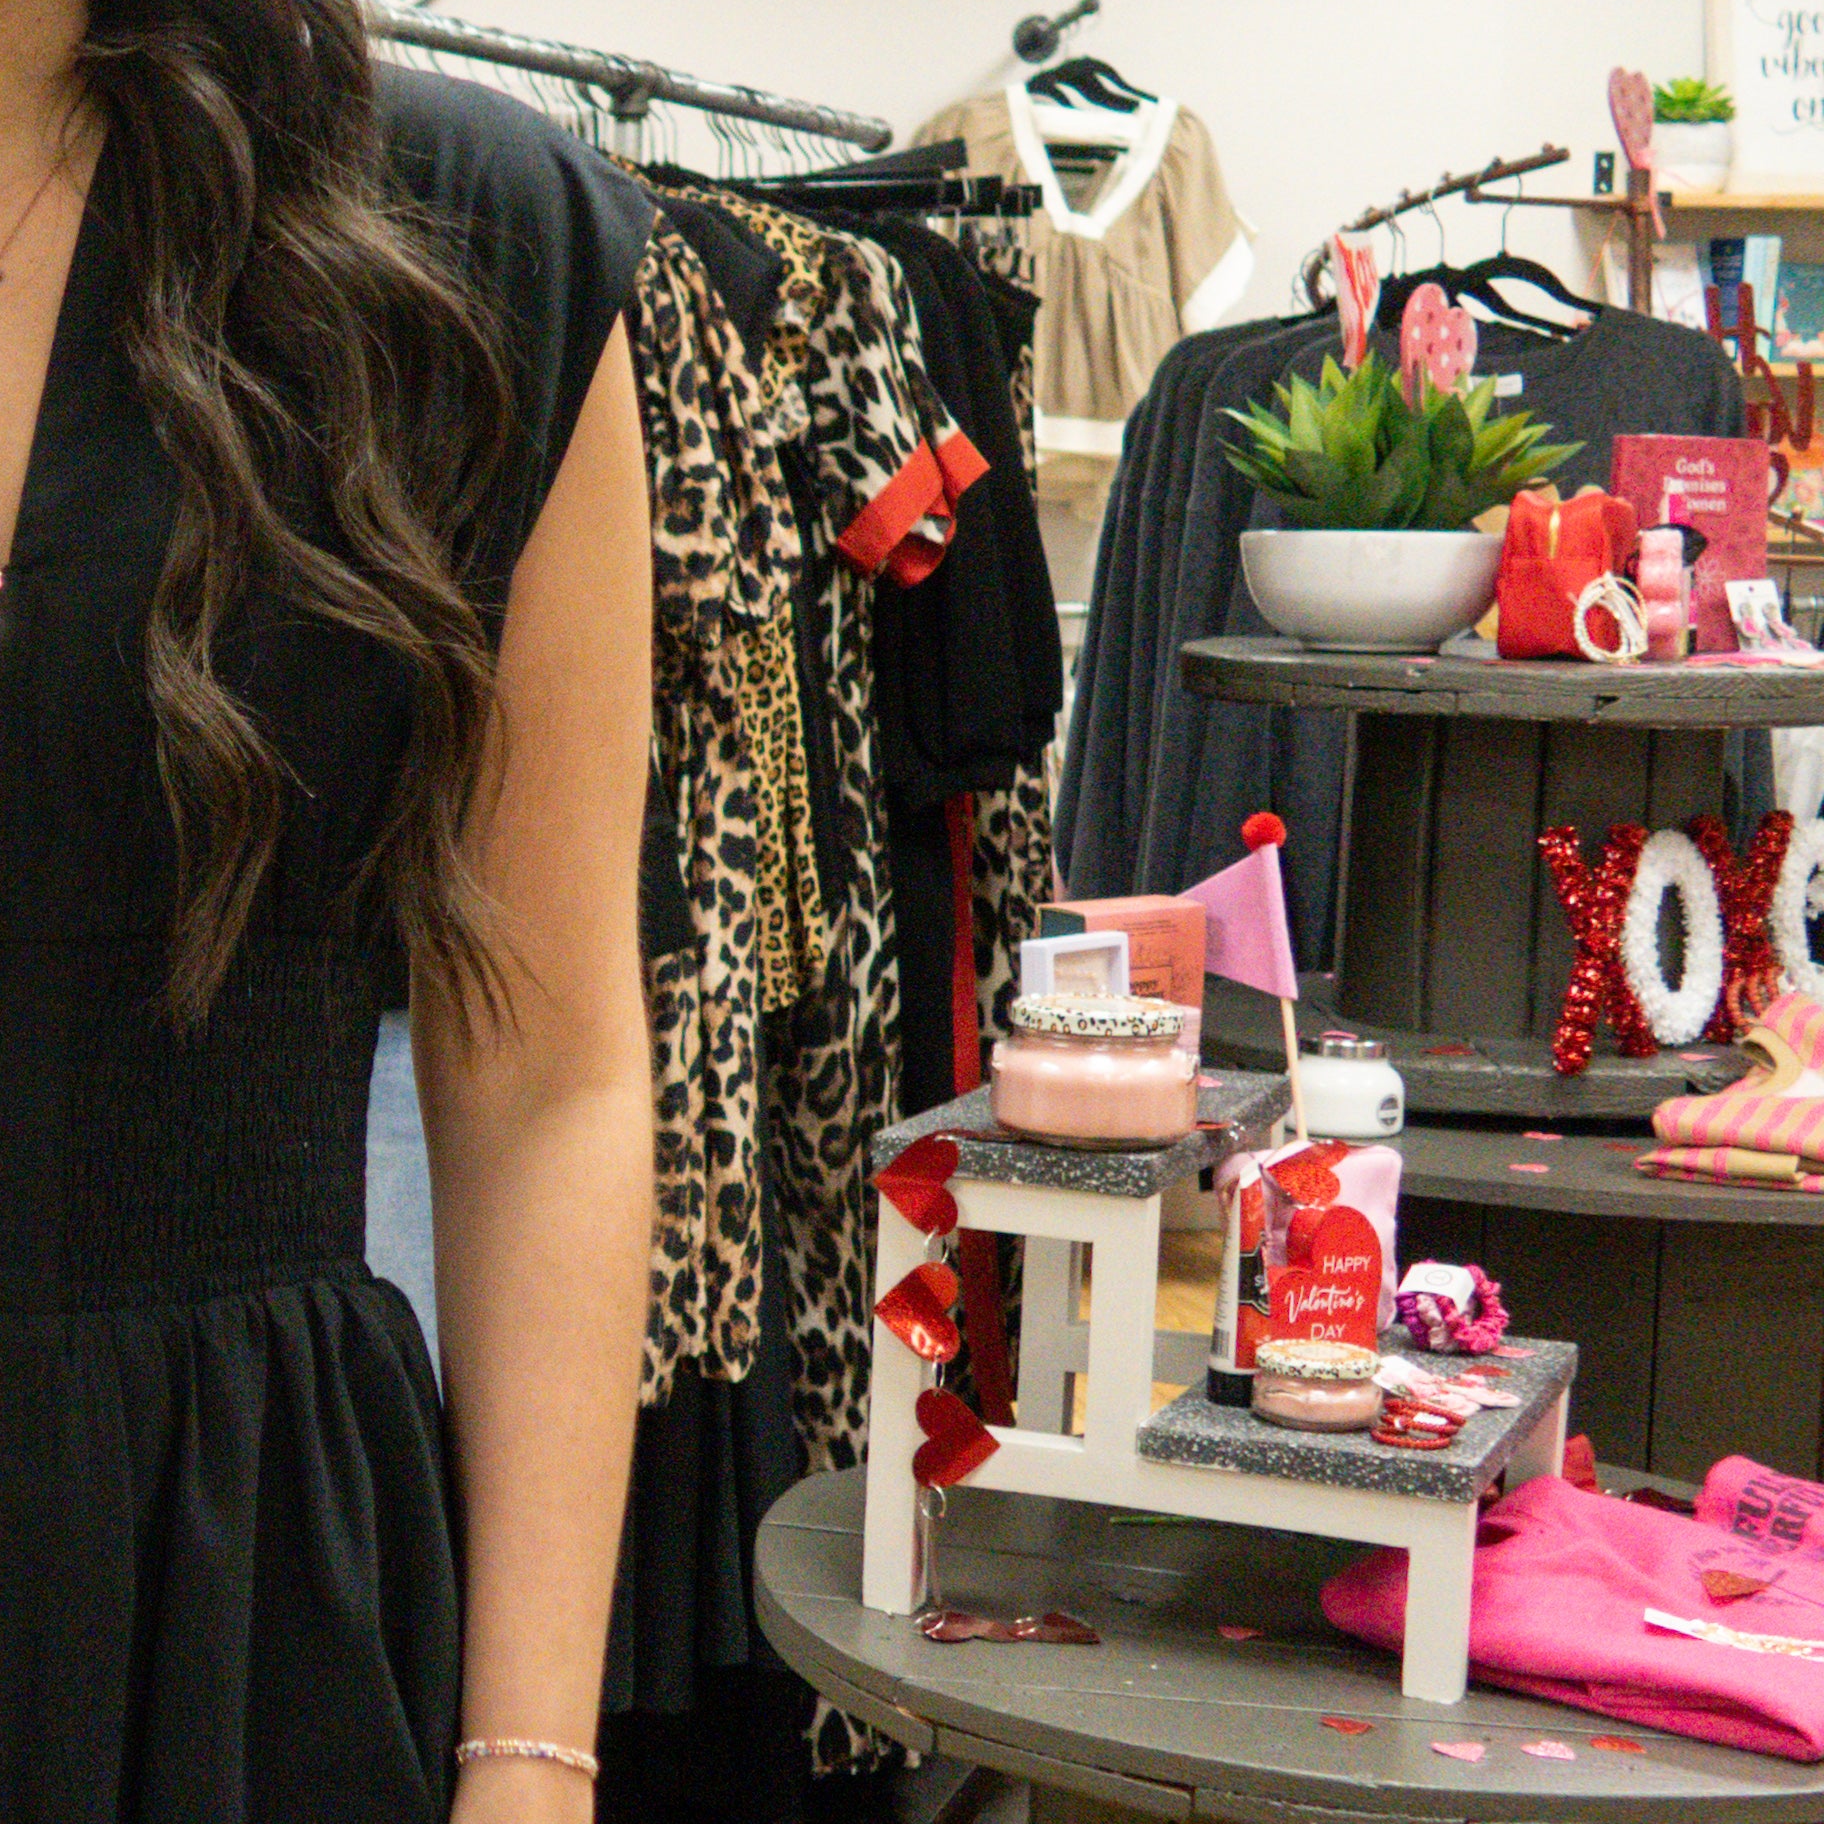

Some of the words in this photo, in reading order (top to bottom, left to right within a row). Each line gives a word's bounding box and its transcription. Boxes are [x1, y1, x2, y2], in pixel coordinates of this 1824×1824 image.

[1676, 458, 1715, 475] God's
[1323, 1255, 1371, 1274] HAPPY
[1286, 1284, 1366, 1324] Valentine's
[1309, 1322, 1348, 1341] DAY
